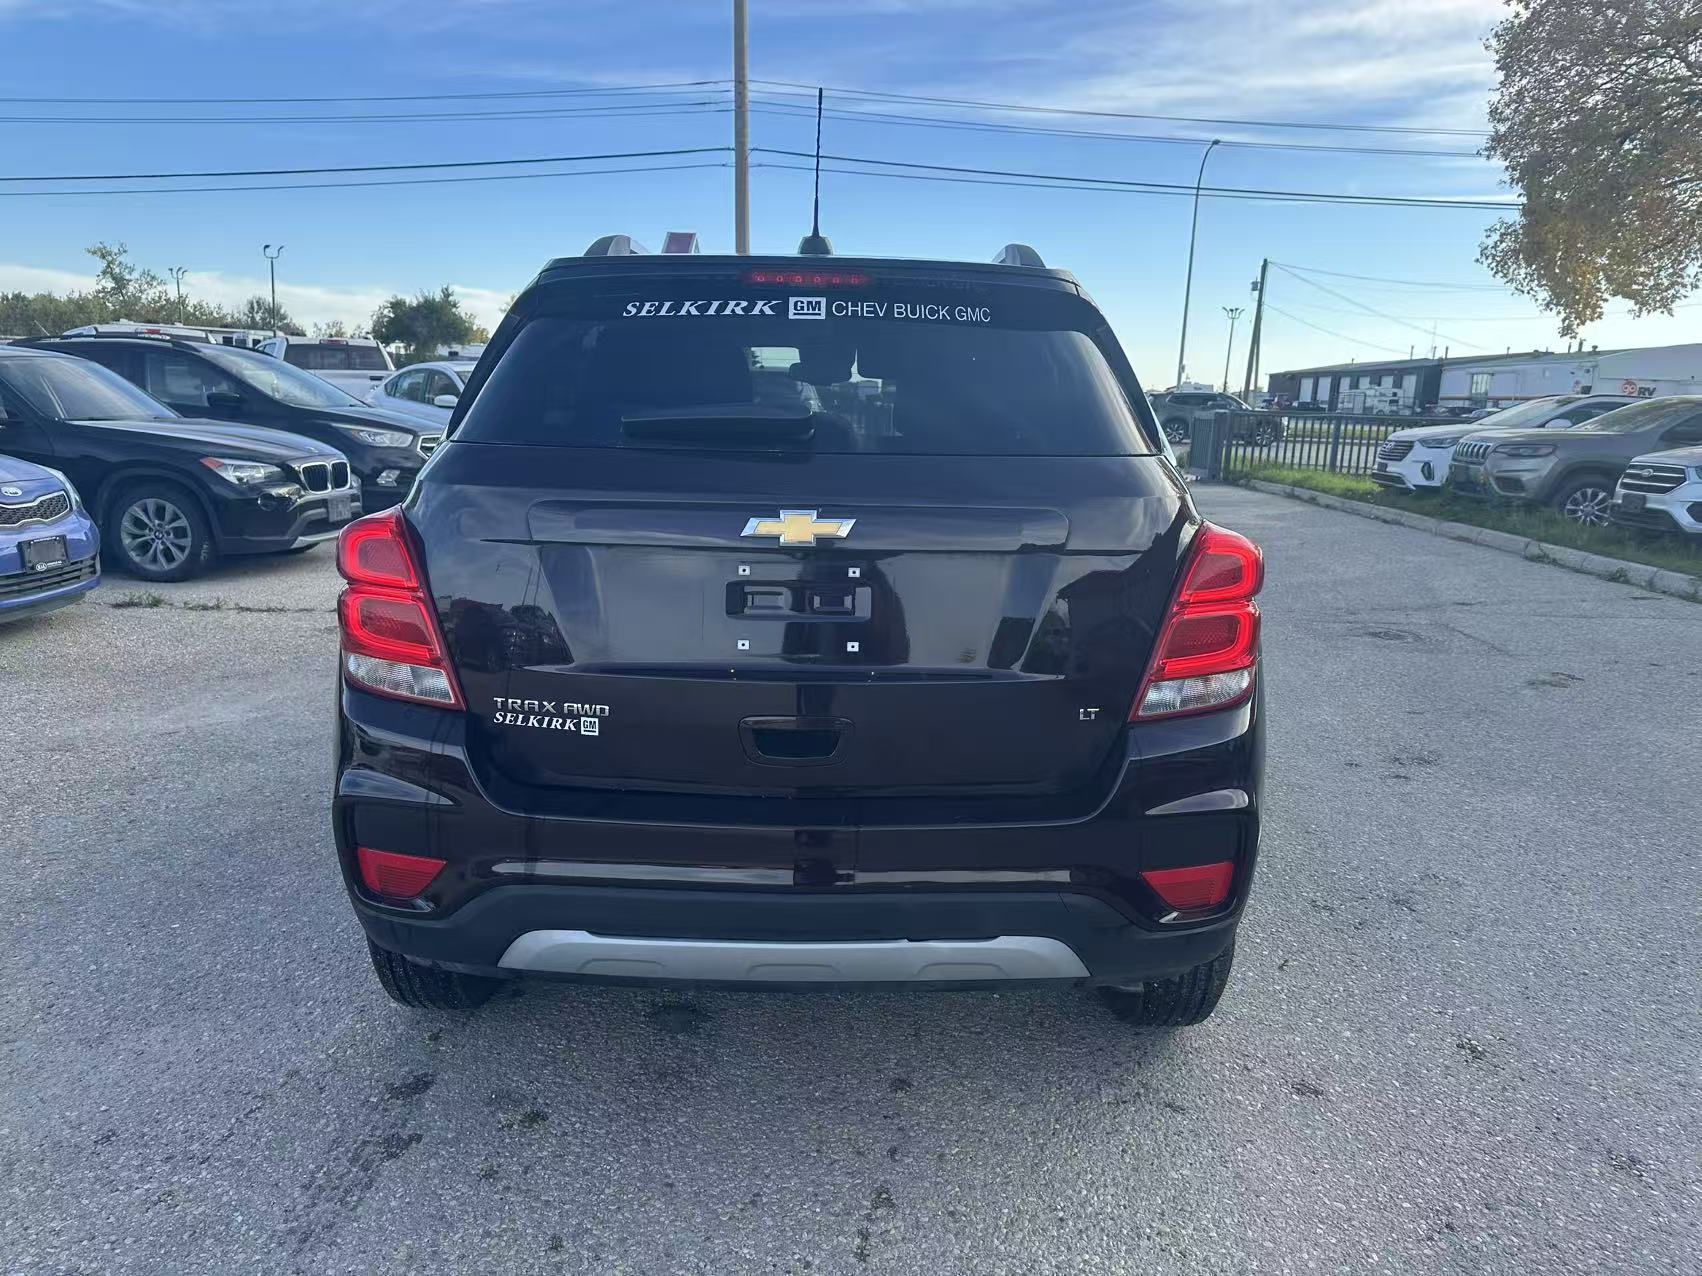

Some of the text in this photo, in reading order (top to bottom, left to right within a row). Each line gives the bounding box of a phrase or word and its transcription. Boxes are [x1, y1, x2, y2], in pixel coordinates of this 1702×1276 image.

[623, 298, 991, 322] SELKIRK GM CHEV BUICK GMC
[1637, 386, 1656, 396] RV
[493, 697, 609, 716] TRAX AWD
[1079, 708, 1099, 720] LT
[493, 711, 598, 733] SELKIRK GM
